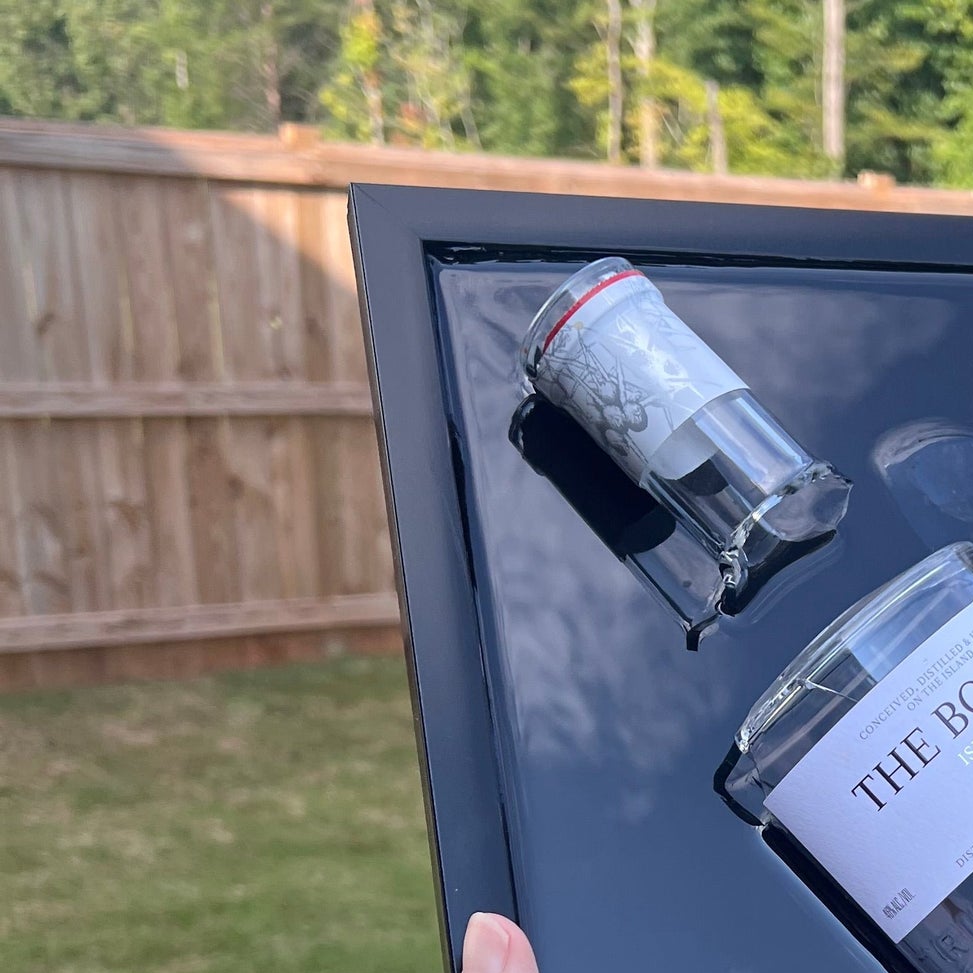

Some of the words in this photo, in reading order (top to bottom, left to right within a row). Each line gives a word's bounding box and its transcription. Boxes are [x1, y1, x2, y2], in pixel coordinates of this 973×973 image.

[859, 686, 919, 740] CONCEIVED,
[916, 643, 964, 686] DISTILLED
[962, 637, 971, 647] &
[906, 696, 923, 712] ON
[922, 677, 943, 697] THE
[851, 726, 941, 811] THE
